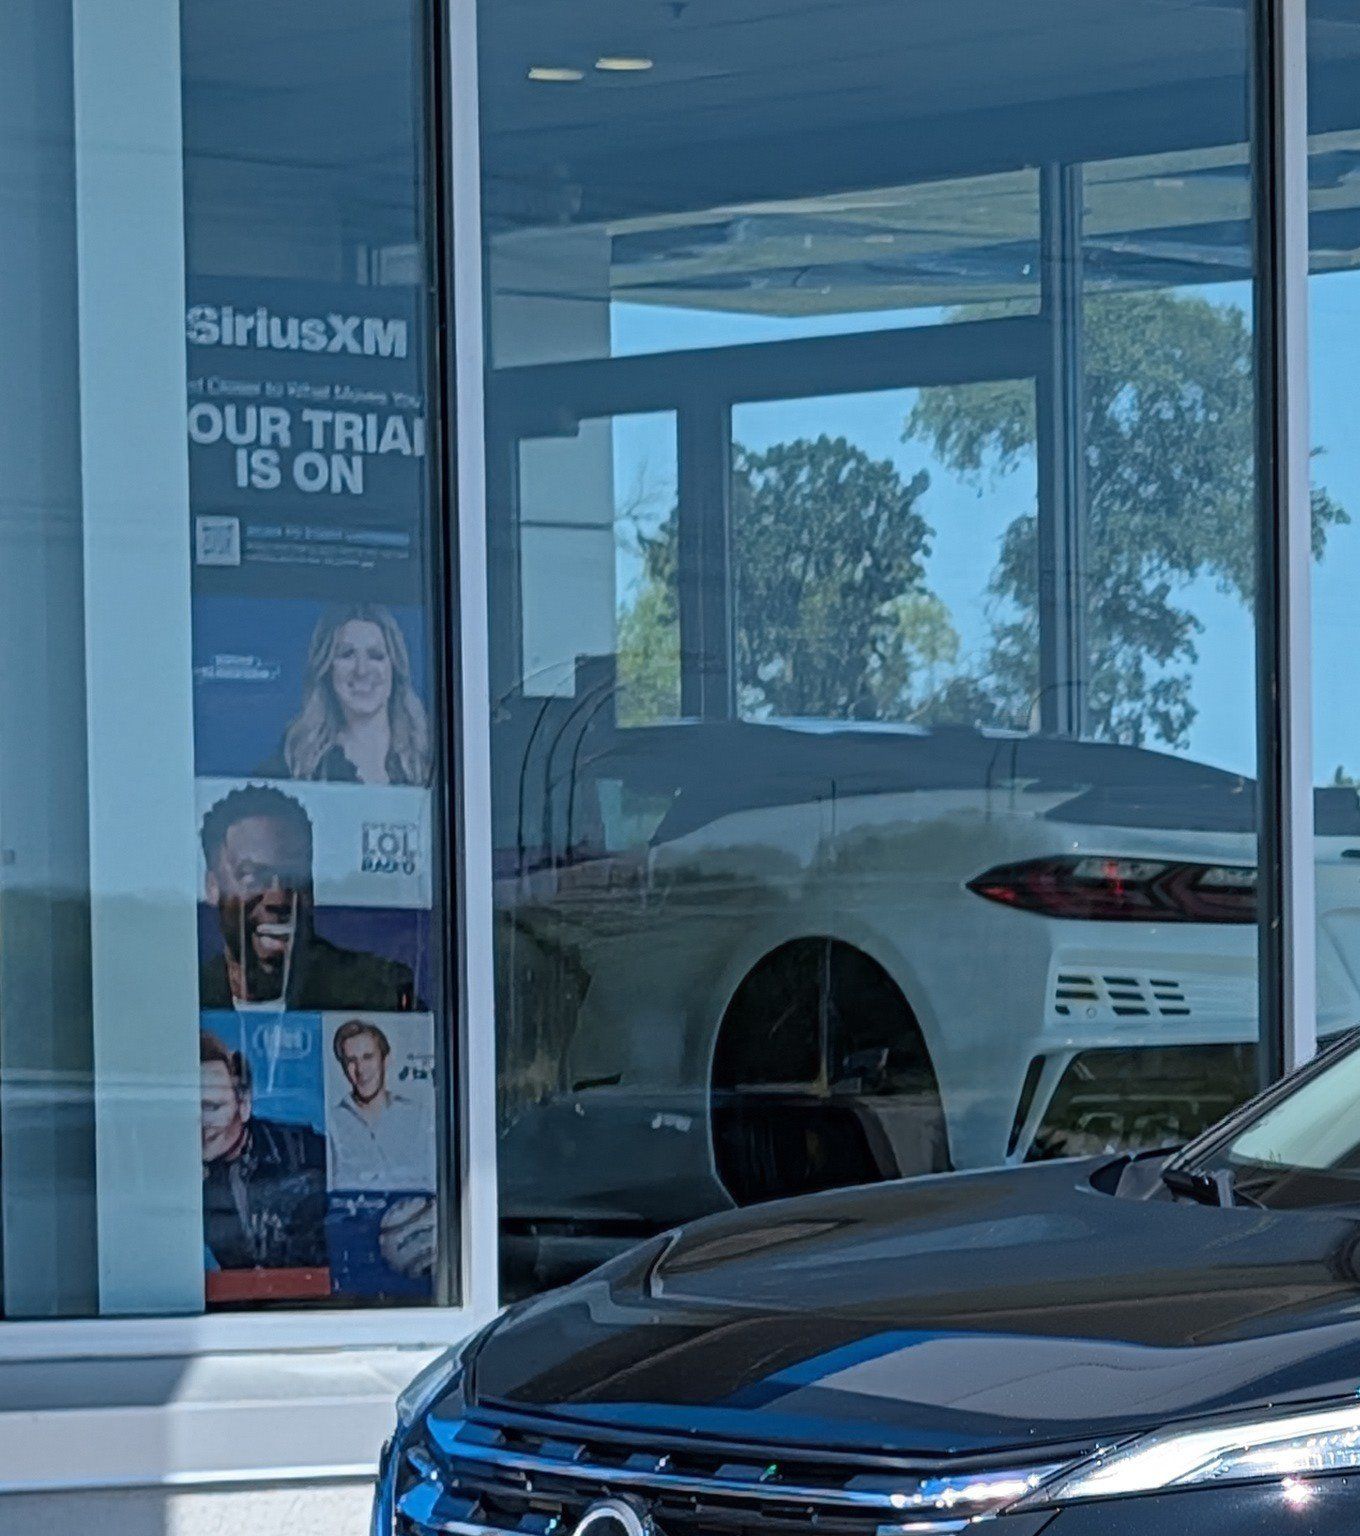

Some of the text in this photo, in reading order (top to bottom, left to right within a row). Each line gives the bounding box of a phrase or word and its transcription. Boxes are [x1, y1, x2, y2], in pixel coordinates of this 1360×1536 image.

[186, 306, 407, 359] SiriusXM
[189, 402, 292, 448] OUR
[236, 448, 364, 495] IS ON
